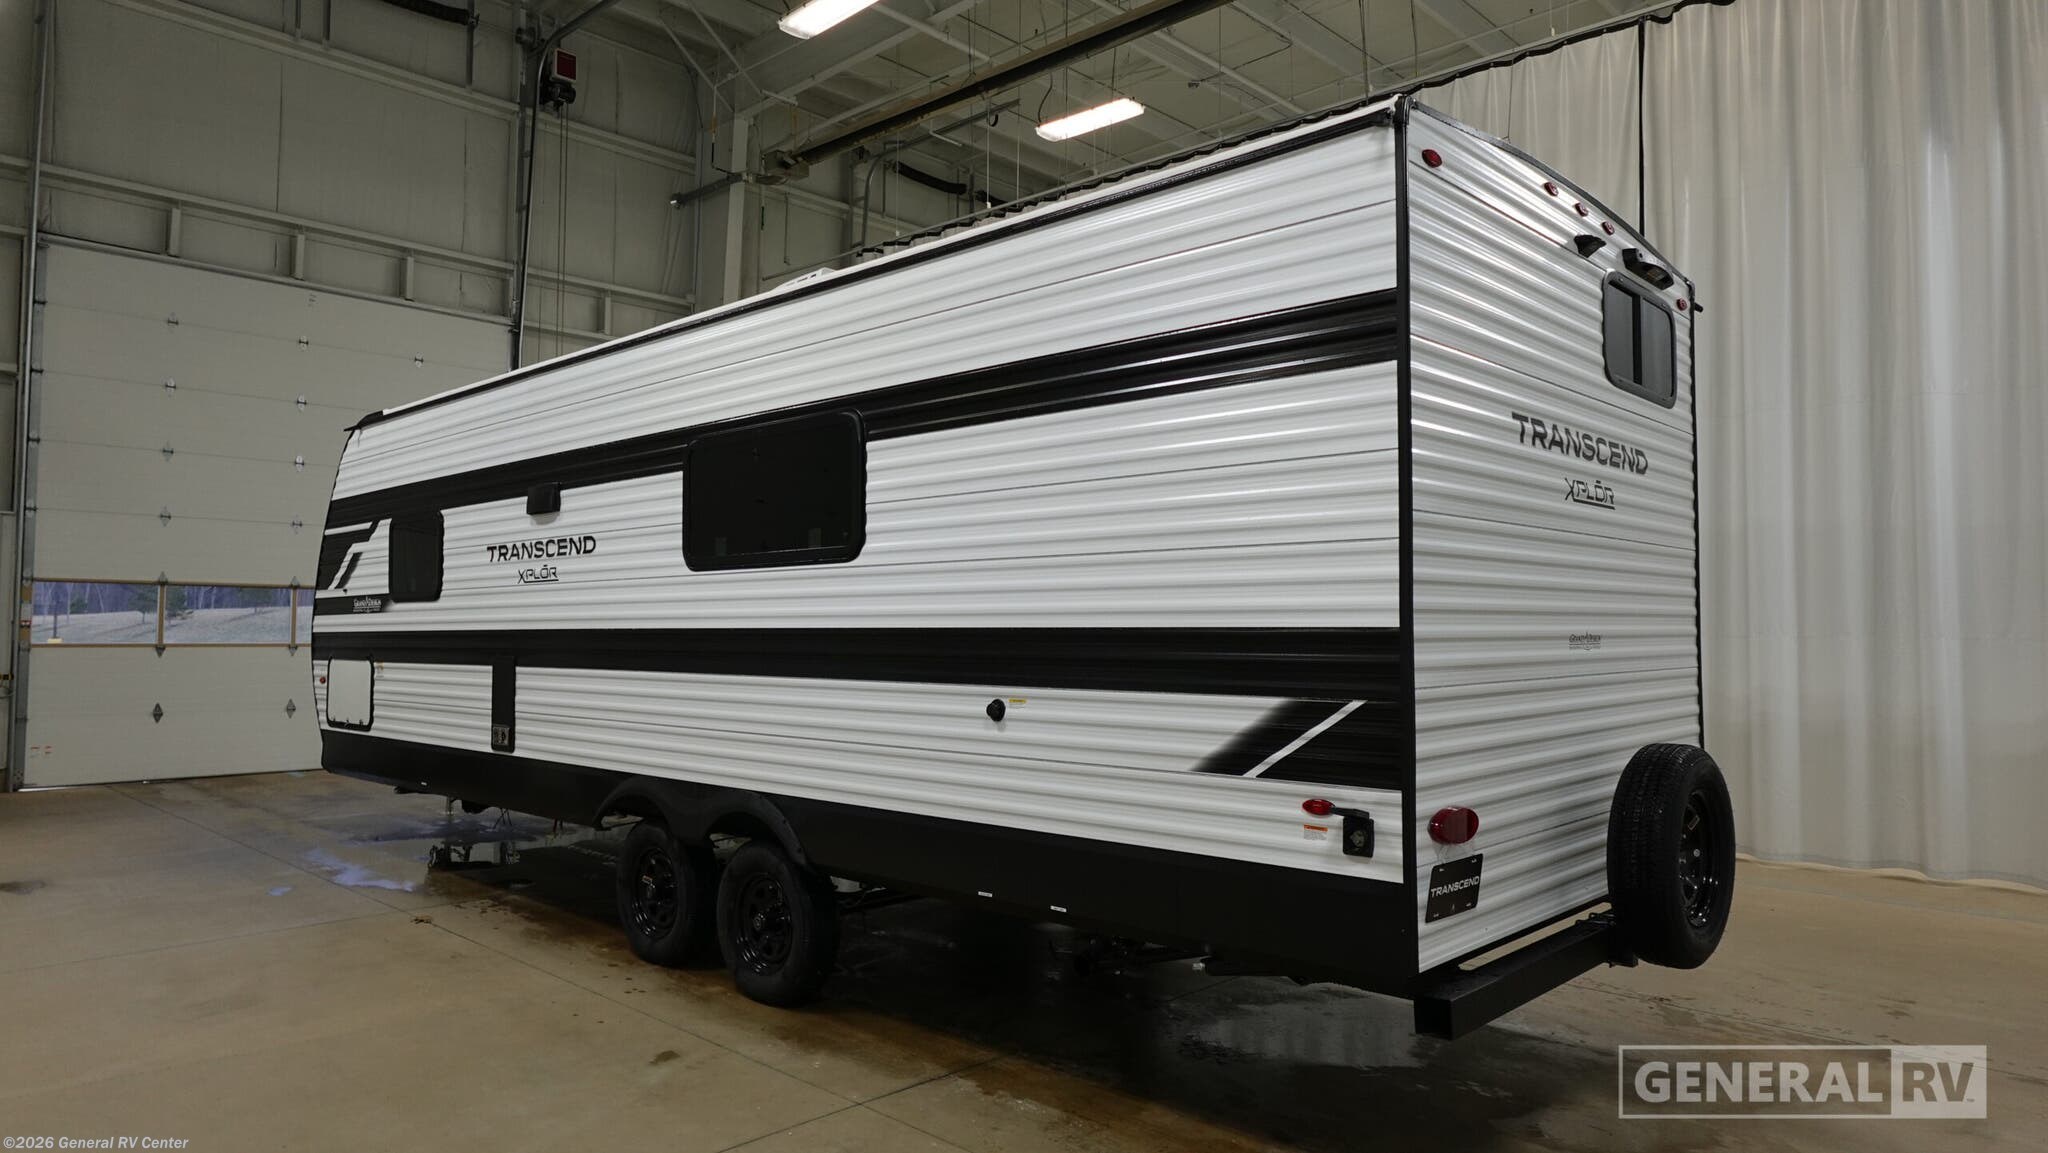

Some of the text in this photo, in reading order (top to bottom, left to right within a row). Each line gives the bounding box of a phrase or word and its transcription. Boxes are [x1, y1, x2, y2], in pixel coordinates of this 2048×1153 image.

[1511, 411, 1649, 475] TRANSCEND
[487, 535, 597, 562] TRANSCEND
[1430, 875, 1480, 898] TRANSCEND
